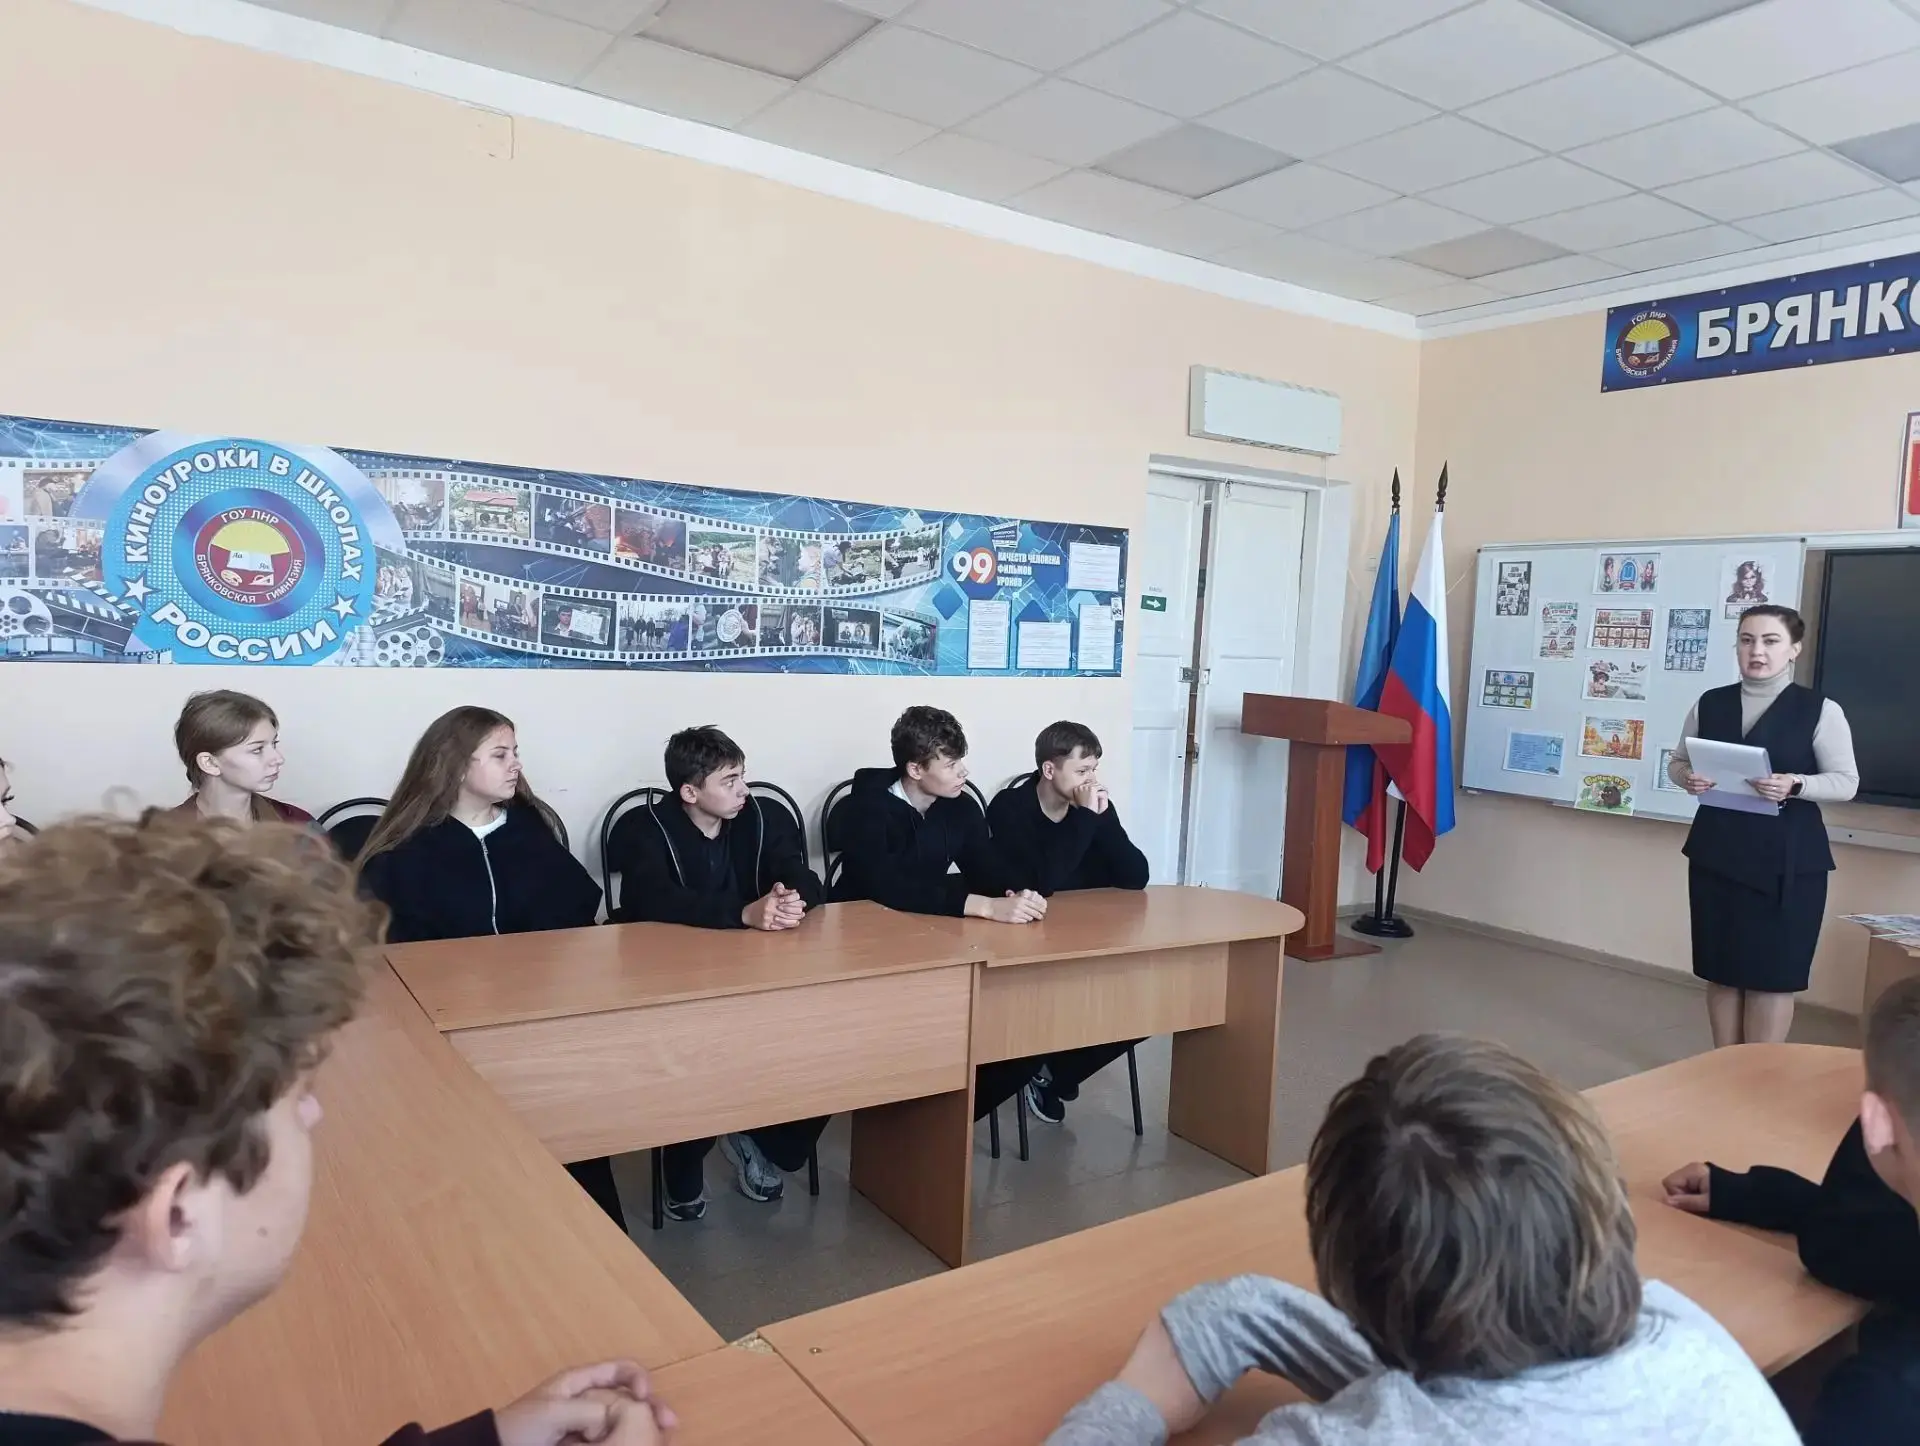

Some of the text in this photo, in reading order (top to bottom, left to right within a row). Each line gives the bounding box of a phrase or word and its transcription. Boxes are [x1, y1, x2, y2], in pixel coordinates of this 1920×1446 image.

[1631, 311, 1667, 325] ГОУ ЛНР
[1615, 339, 1678, 376] БРЯНКОВСКАЯ ГИМНАЗИЯ
[125, 447, 364, 581] КИНОУРОКИ В ШКОЛАХ
[220, 509, 279, 524] ГОУ ЛНР
[197, 554, 302, 603] БРЯНКОВСКАЯ ГИМНАЗИЯ
[952, 550, 993, 583] 99
[150, 601, 338, 662] РОССИИ
